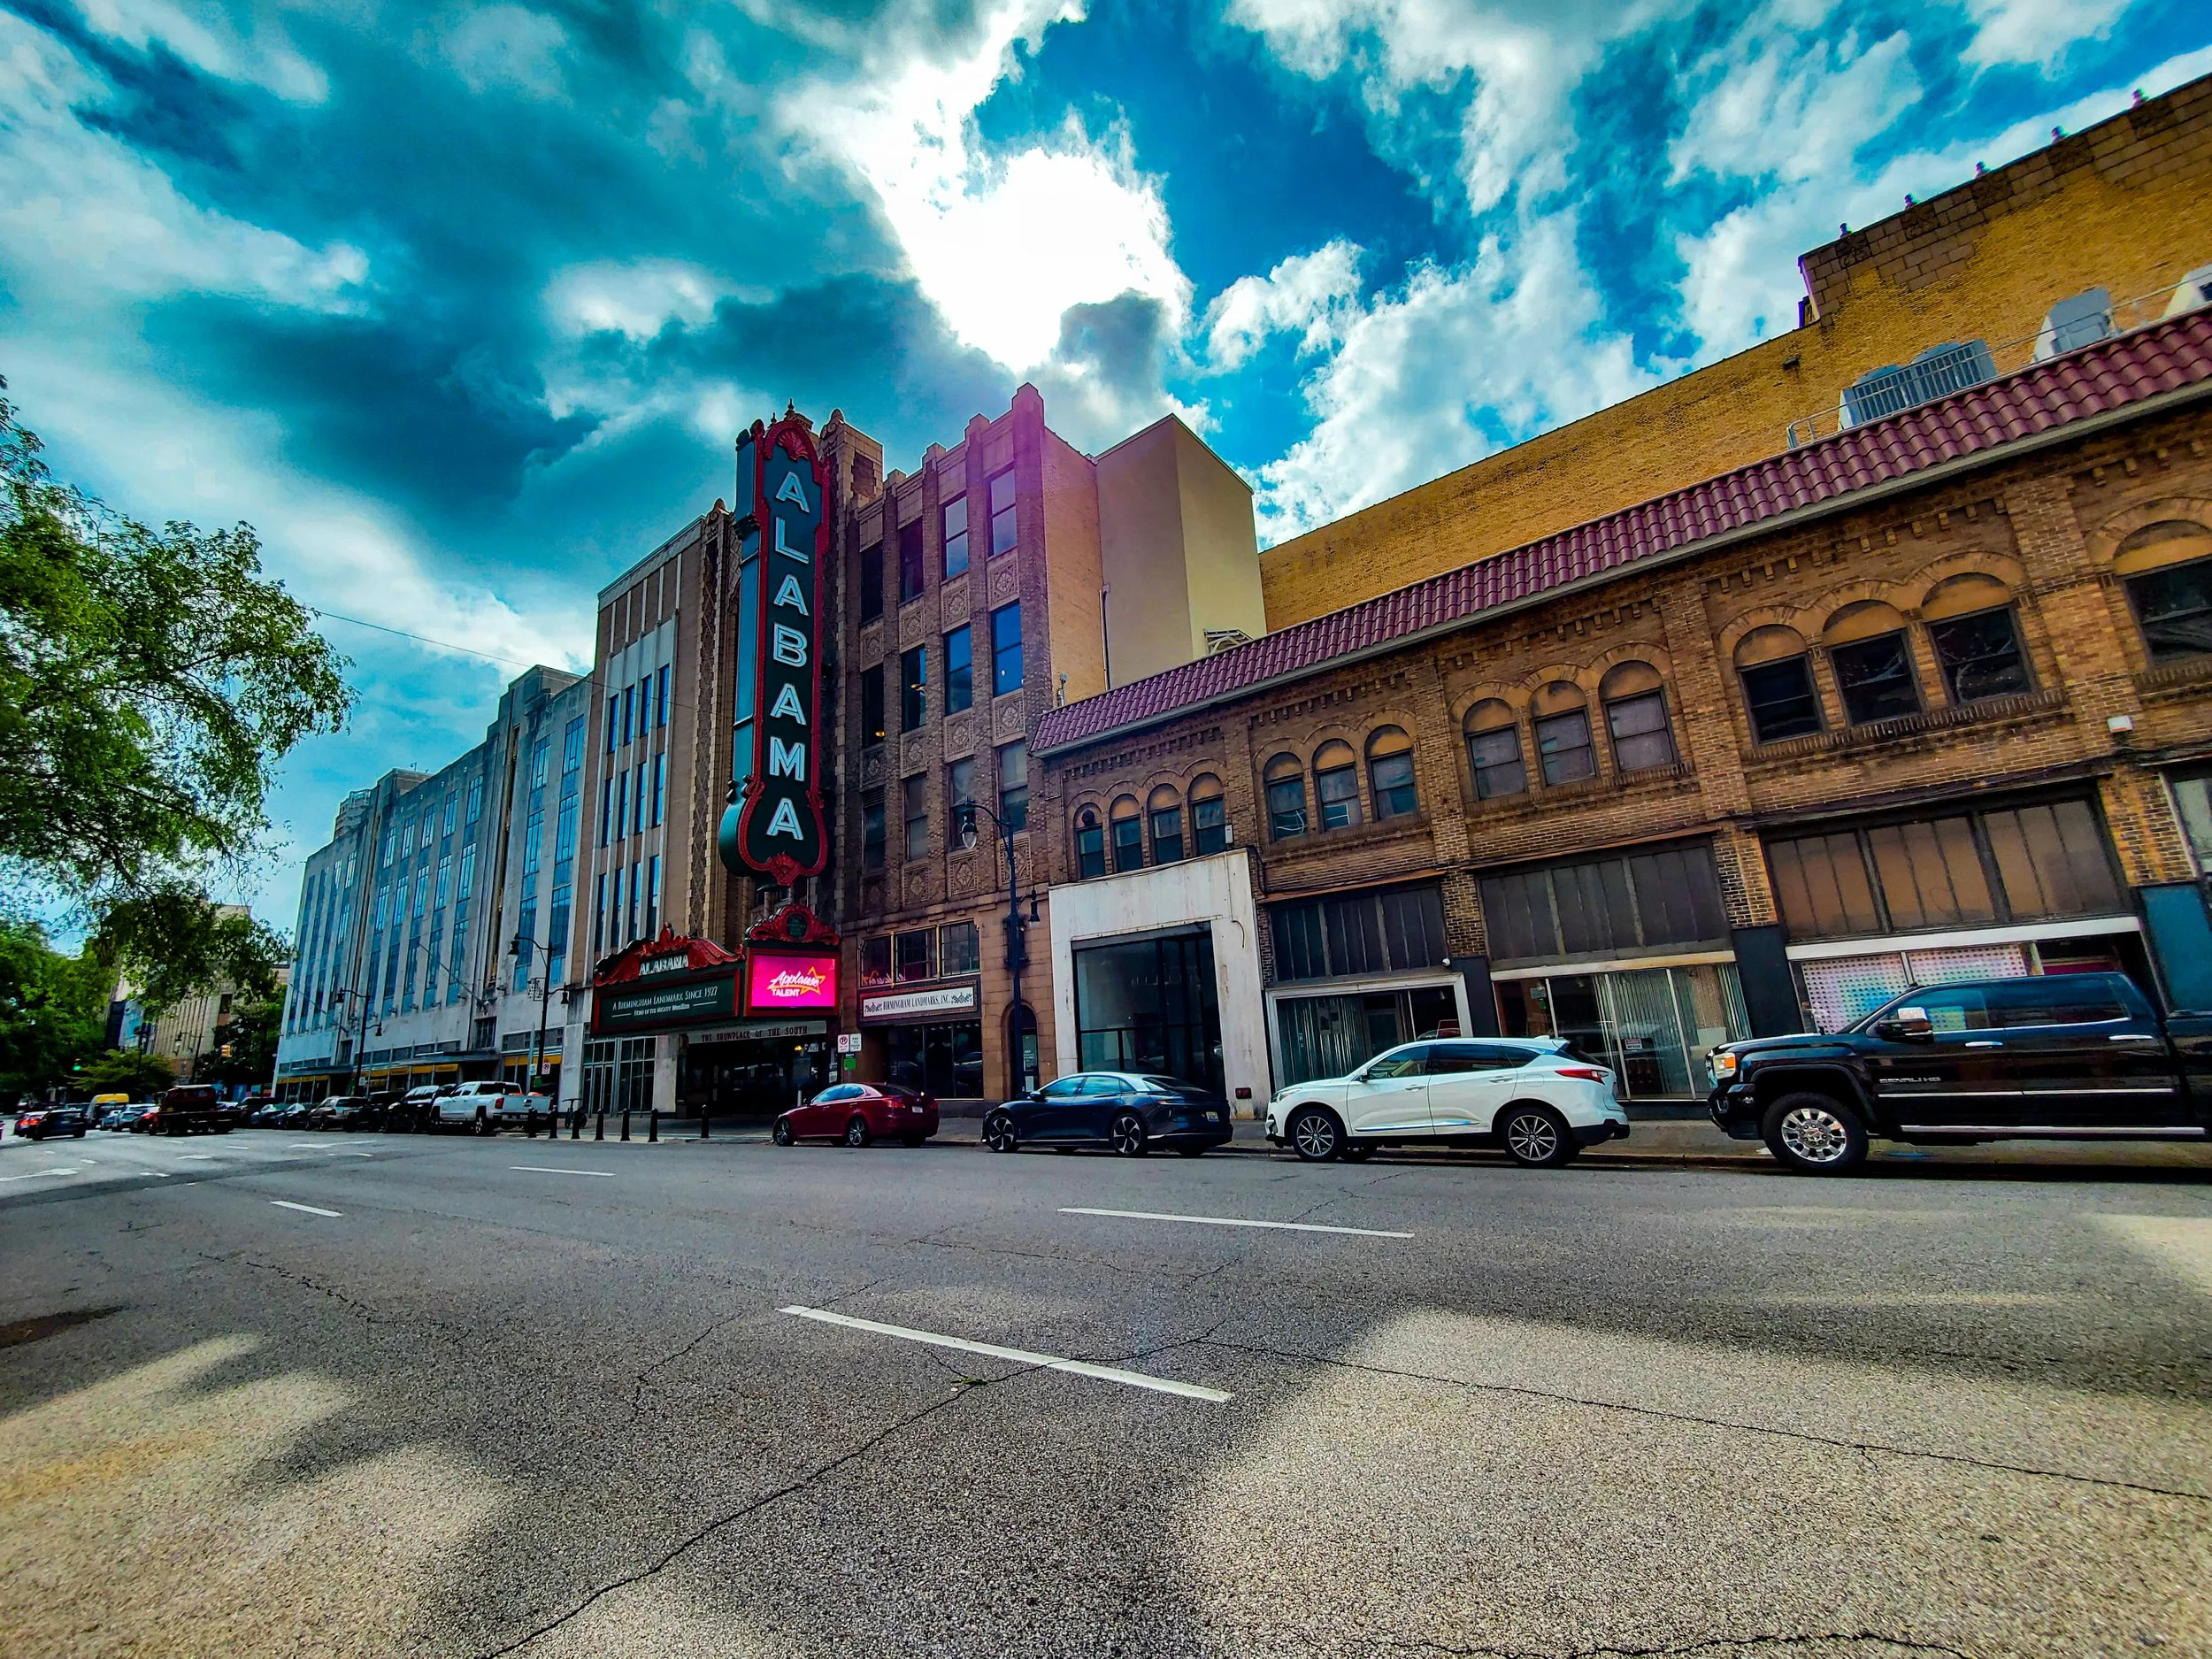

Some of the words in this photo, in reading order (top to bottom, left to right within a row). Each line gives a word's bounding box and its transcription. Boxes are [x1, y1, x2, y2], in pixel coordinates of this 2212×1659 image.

[764, 471, 810, 841] ALABAMA
[639, 955, 688, 976] ALABAMA
[767, 971, 819, 988] Applause
[612, 1002, 617, 1010] A
[618, 998, 652, 1010] BIRMINGHAM
[653, 993, 684, 1005] LANDMARK
[685, 989, 703, 1001] SINCE
[704, 986, 718, 997] 1927
[772, 988, 800, 997] TALENT
[883, 998, 910, 1010] BIRMINGHAM
[911, 995, 940, 1008] LANDMARKS,
[941, 994, 950, 1005] INC.
[716, 1031, 750, 1041] SHOWPLACE
[785, 1026, 808, 1035] SOUTH
